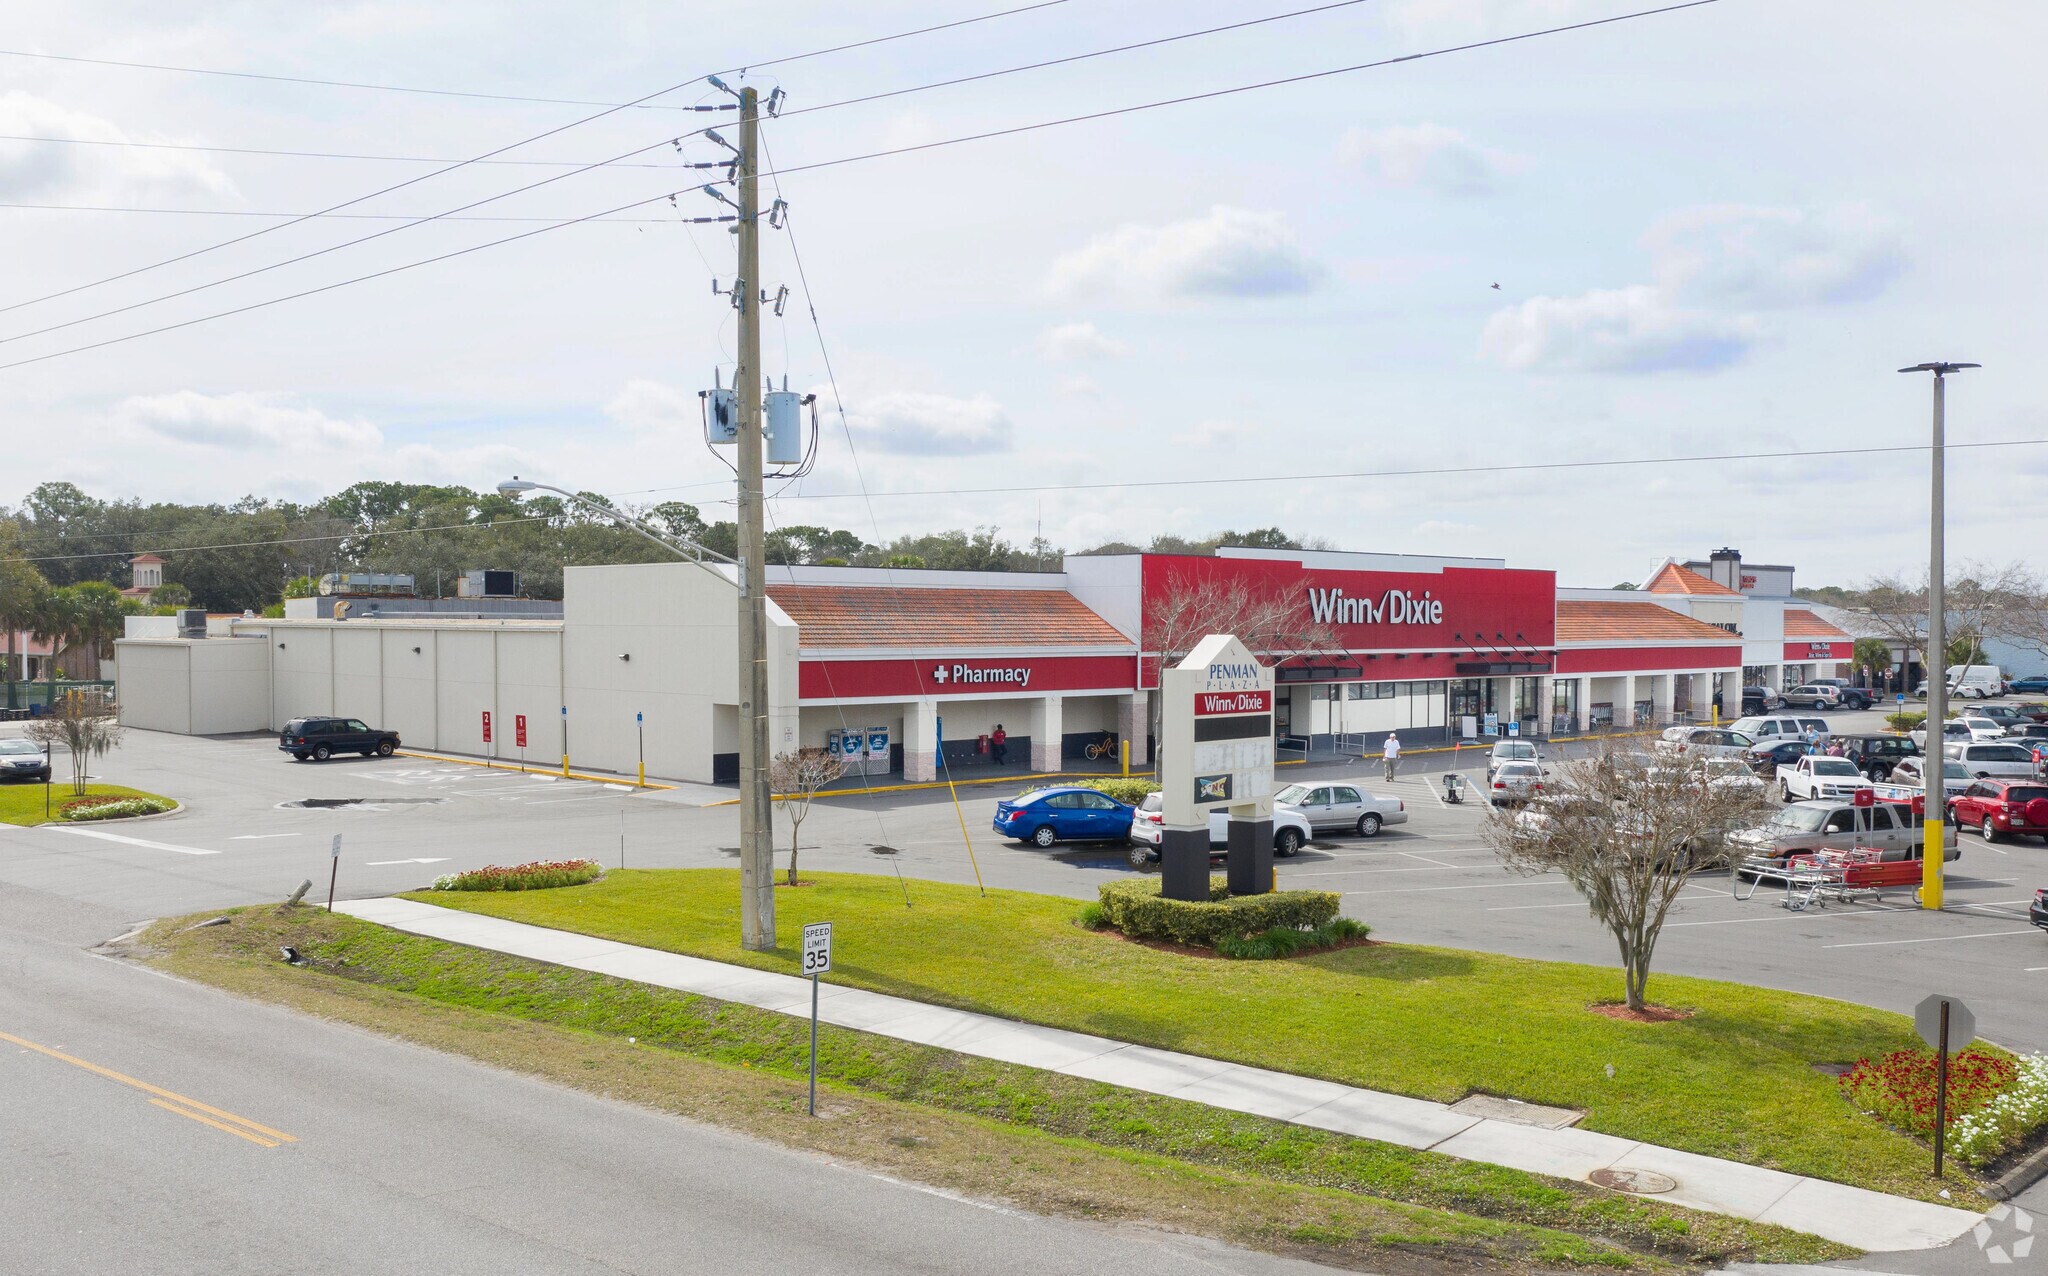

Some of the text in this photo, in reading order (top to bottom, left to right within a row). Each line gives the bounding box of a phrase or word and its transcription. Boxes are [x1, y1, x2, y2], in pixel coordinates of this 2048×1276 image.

[1308, 588, 1443, 624] Winn Dixie
[953, 664, 1031, 687] Pharmacy
[1209, 664, 1258, 680] PENMAN
[1204, 694, 1263, 712] Winn Dixie
[484, 713, 489, 723] 2
[805, 928, 830, 938] SPEED
[807, 938, 827, 949] LIMIT
[805, 949, 828, 970] 35
